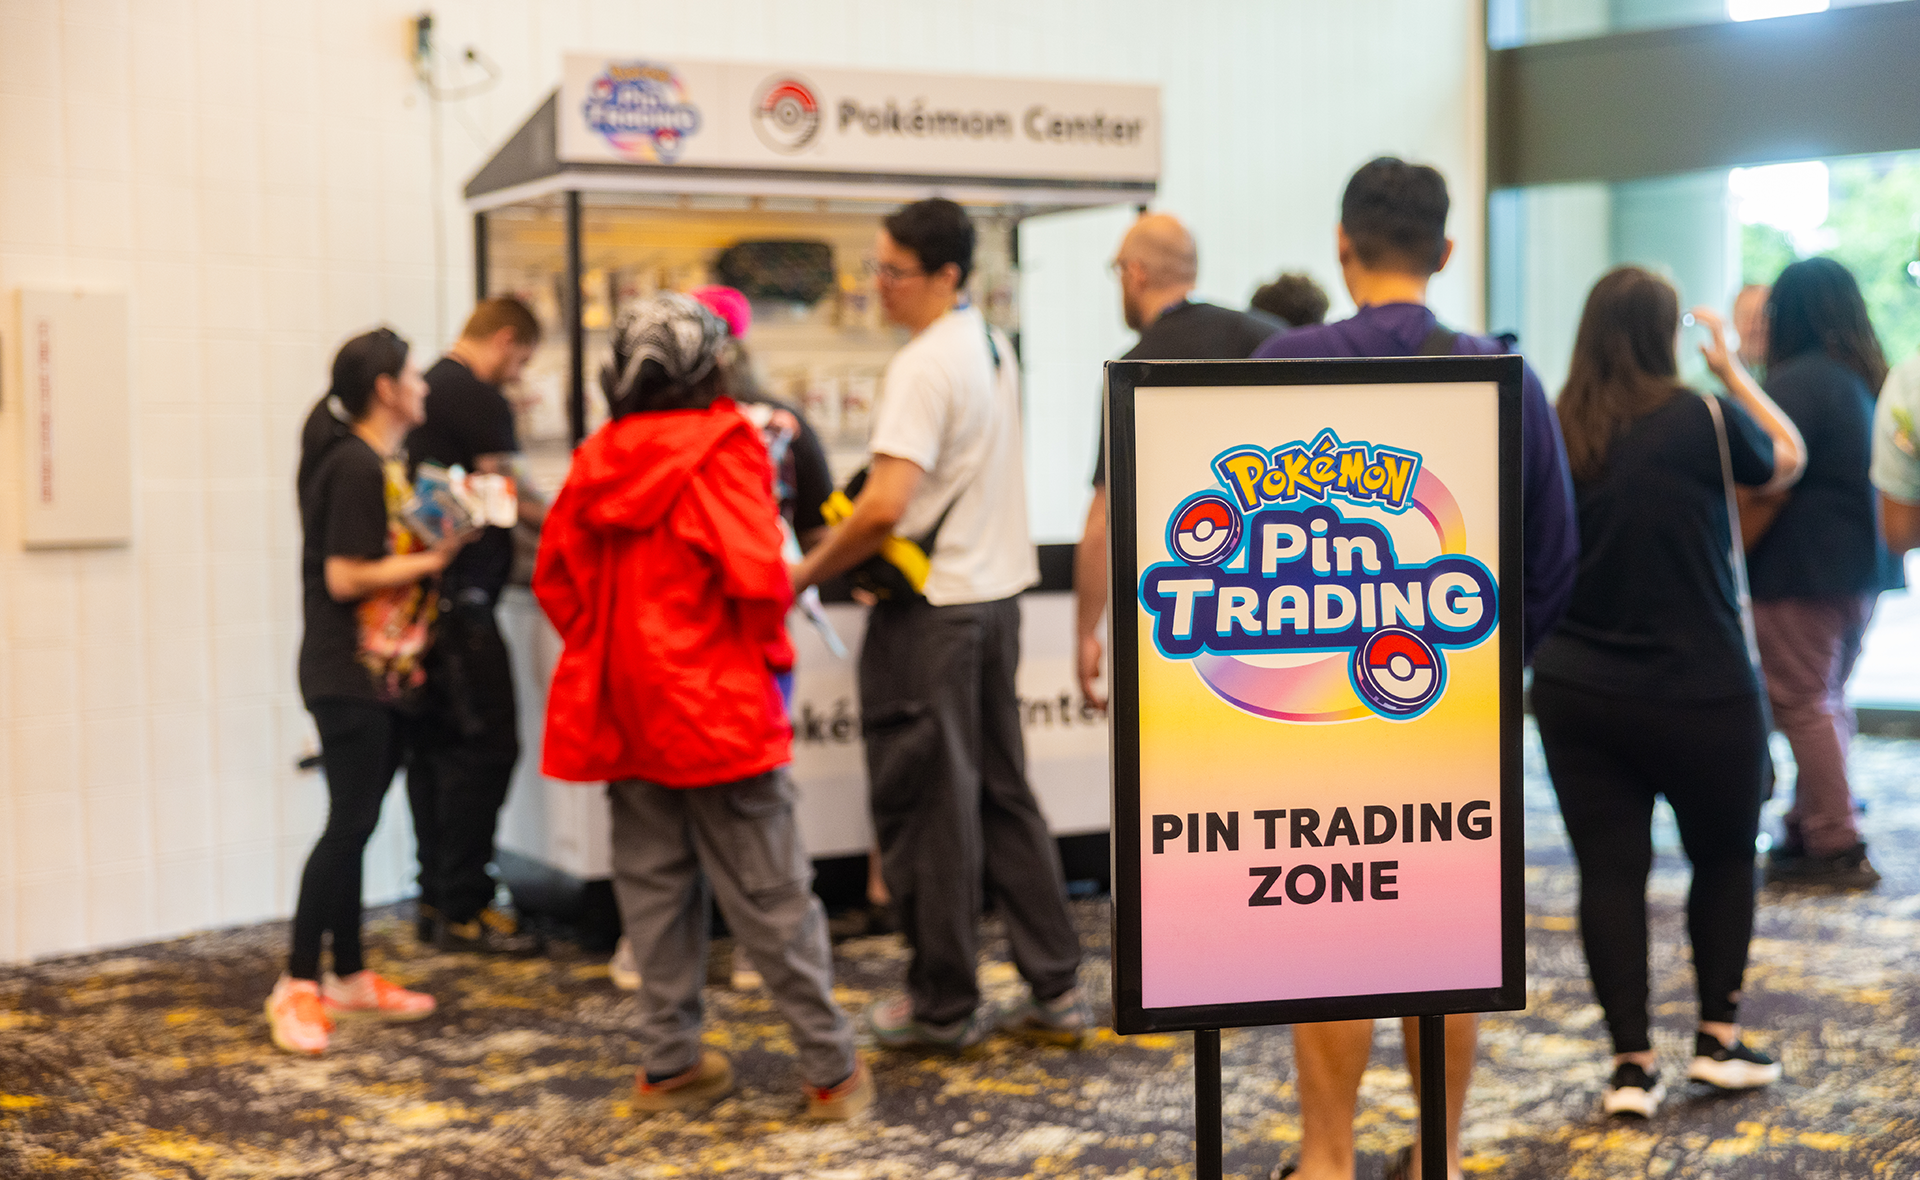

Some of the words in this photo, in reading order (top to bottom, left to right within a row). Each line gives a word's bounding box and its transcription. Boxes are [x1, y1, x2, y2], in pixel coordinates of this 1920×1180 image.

[839, 98, 1012, 137] Pokémon
[1023, 104, 1141, 144] Center
[1262, 519, 1381, 576] Pin
[1157, 572, 1484, 638] TRADING
[1152, 811, 1239, 854] PIN
[1253, 800, 1493, 849] TRADING
[1248, 860, 1399, 907] ZONE
